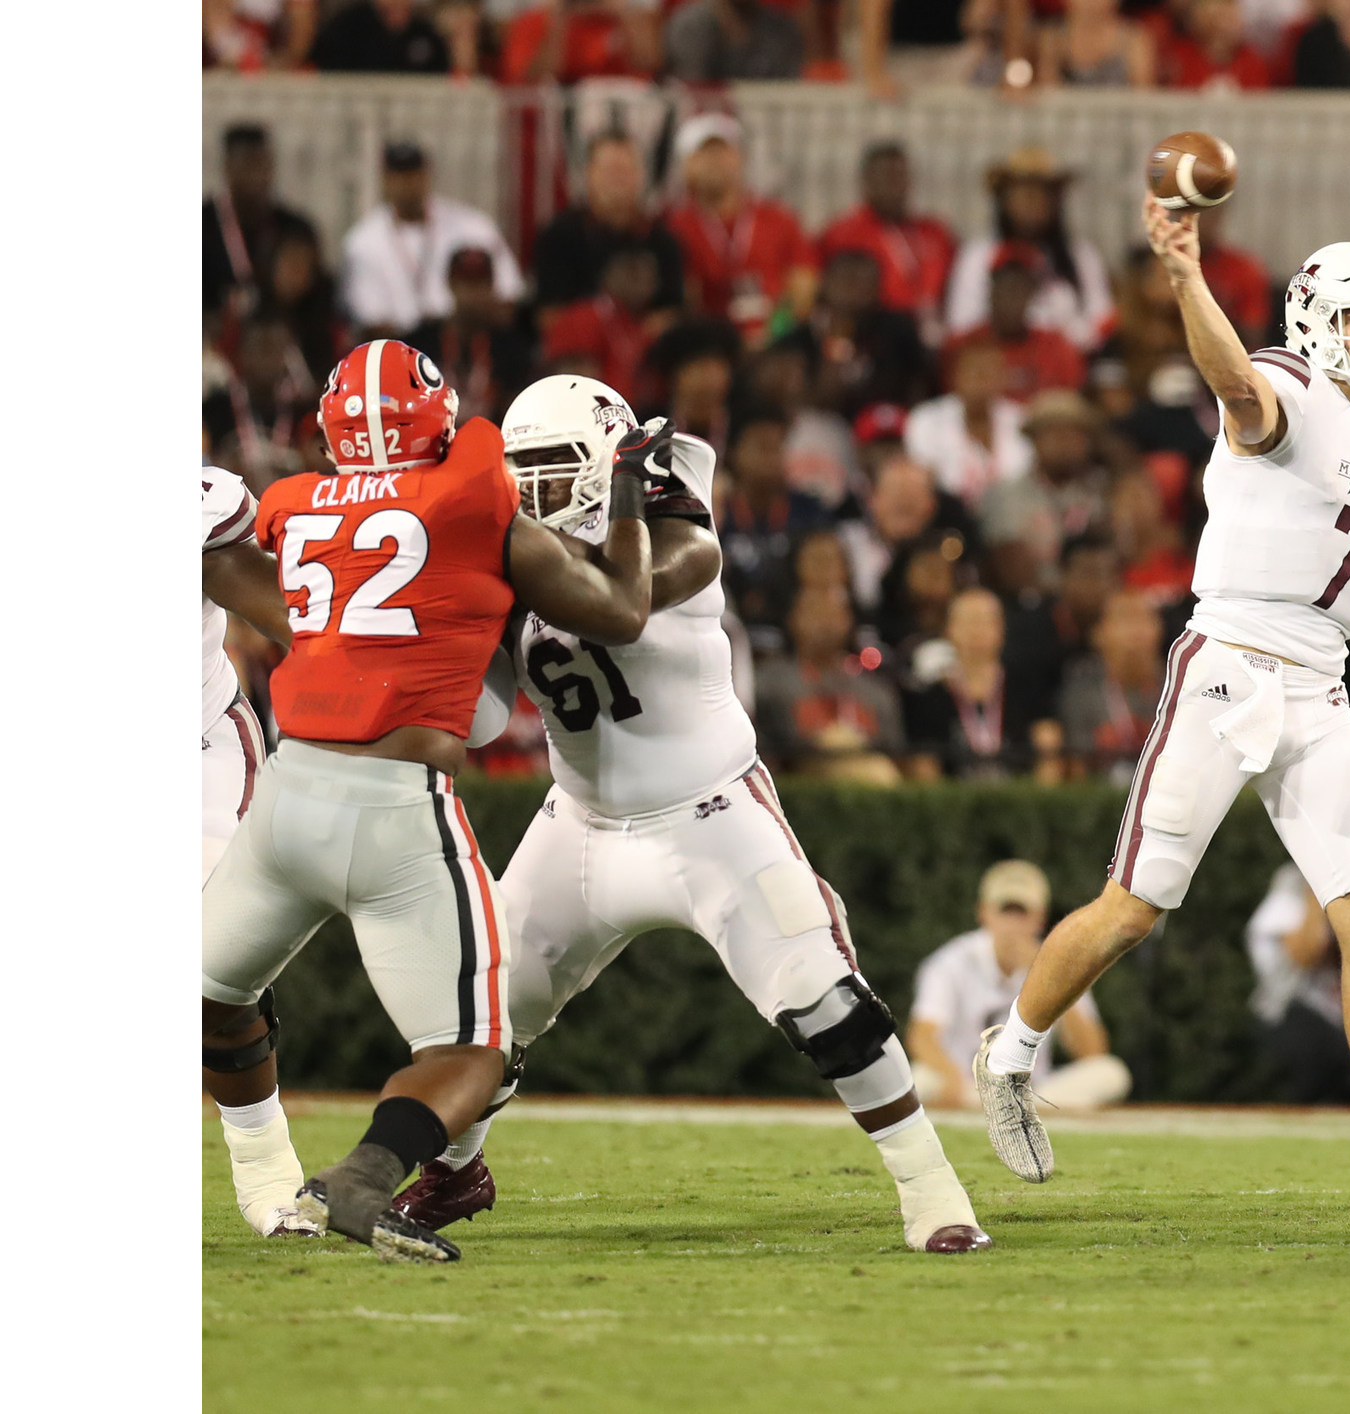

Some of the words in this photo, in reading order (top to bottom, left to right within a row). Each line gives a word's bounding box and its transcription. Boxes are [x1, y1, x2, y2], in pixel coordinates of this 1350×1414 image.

[312, 473, 403, 508] CLARK
[282, 508, 429, 636] 52
[527, 637, 643, 732] 61
[1201, 690, 1231, 702] adidas
